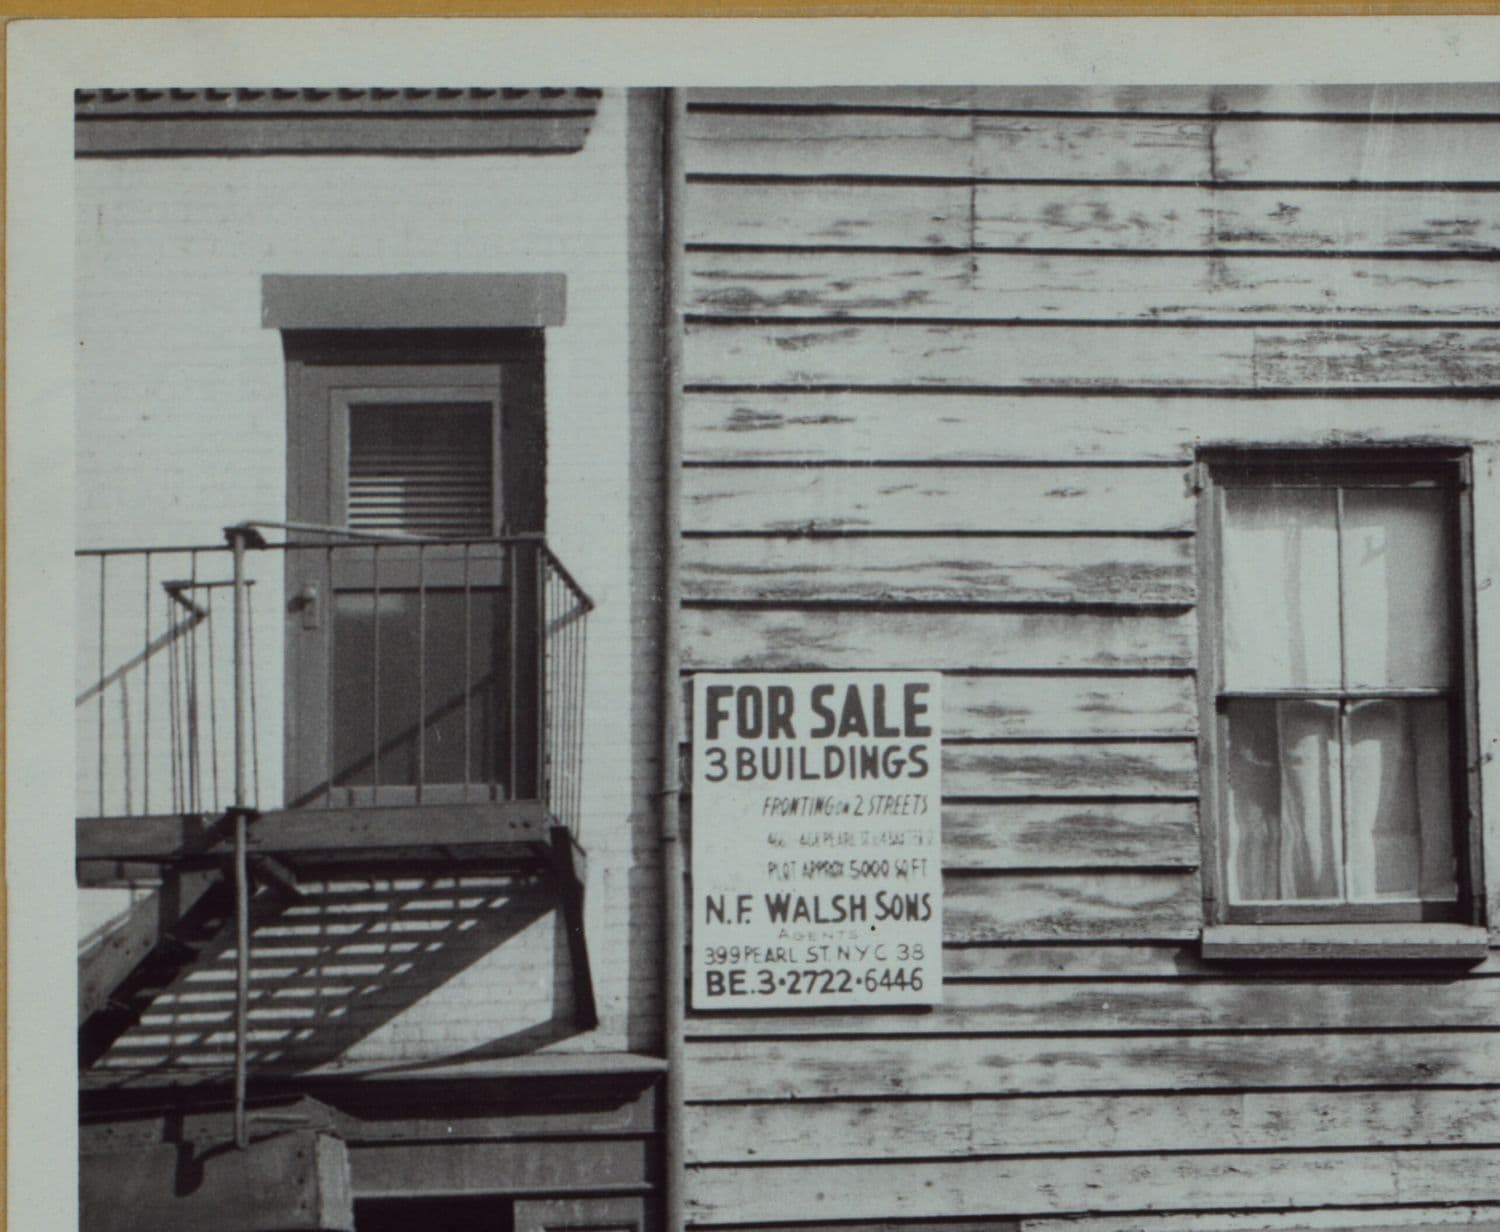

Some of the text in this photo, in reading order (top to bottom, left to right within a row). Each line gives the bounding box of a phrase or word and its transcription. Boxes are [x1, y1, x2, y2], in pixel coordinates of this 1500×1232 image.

[705, 683, 932, 740] FOR SALE
[704, 744, 930, 783] 3 BUILDINGS
[762, 796, 833, 817] FRONTING
[853, 794, 865, 817] 2
[867, 794, 929, 817] STREETS
[768, 861, 796, 881] PLOT
[849, 859, 890, 880] 5000
[911, 858, 928, 878] FT
[764, 893, 867, 924] WALSH
[874, 890, 932, 922] SONS
[777, 928, 859, 942] AGENTS
[705, 946, 740, 965] 399
[744, 946, 798, 964] PEARL
[898, 943, 925, 961] 38
